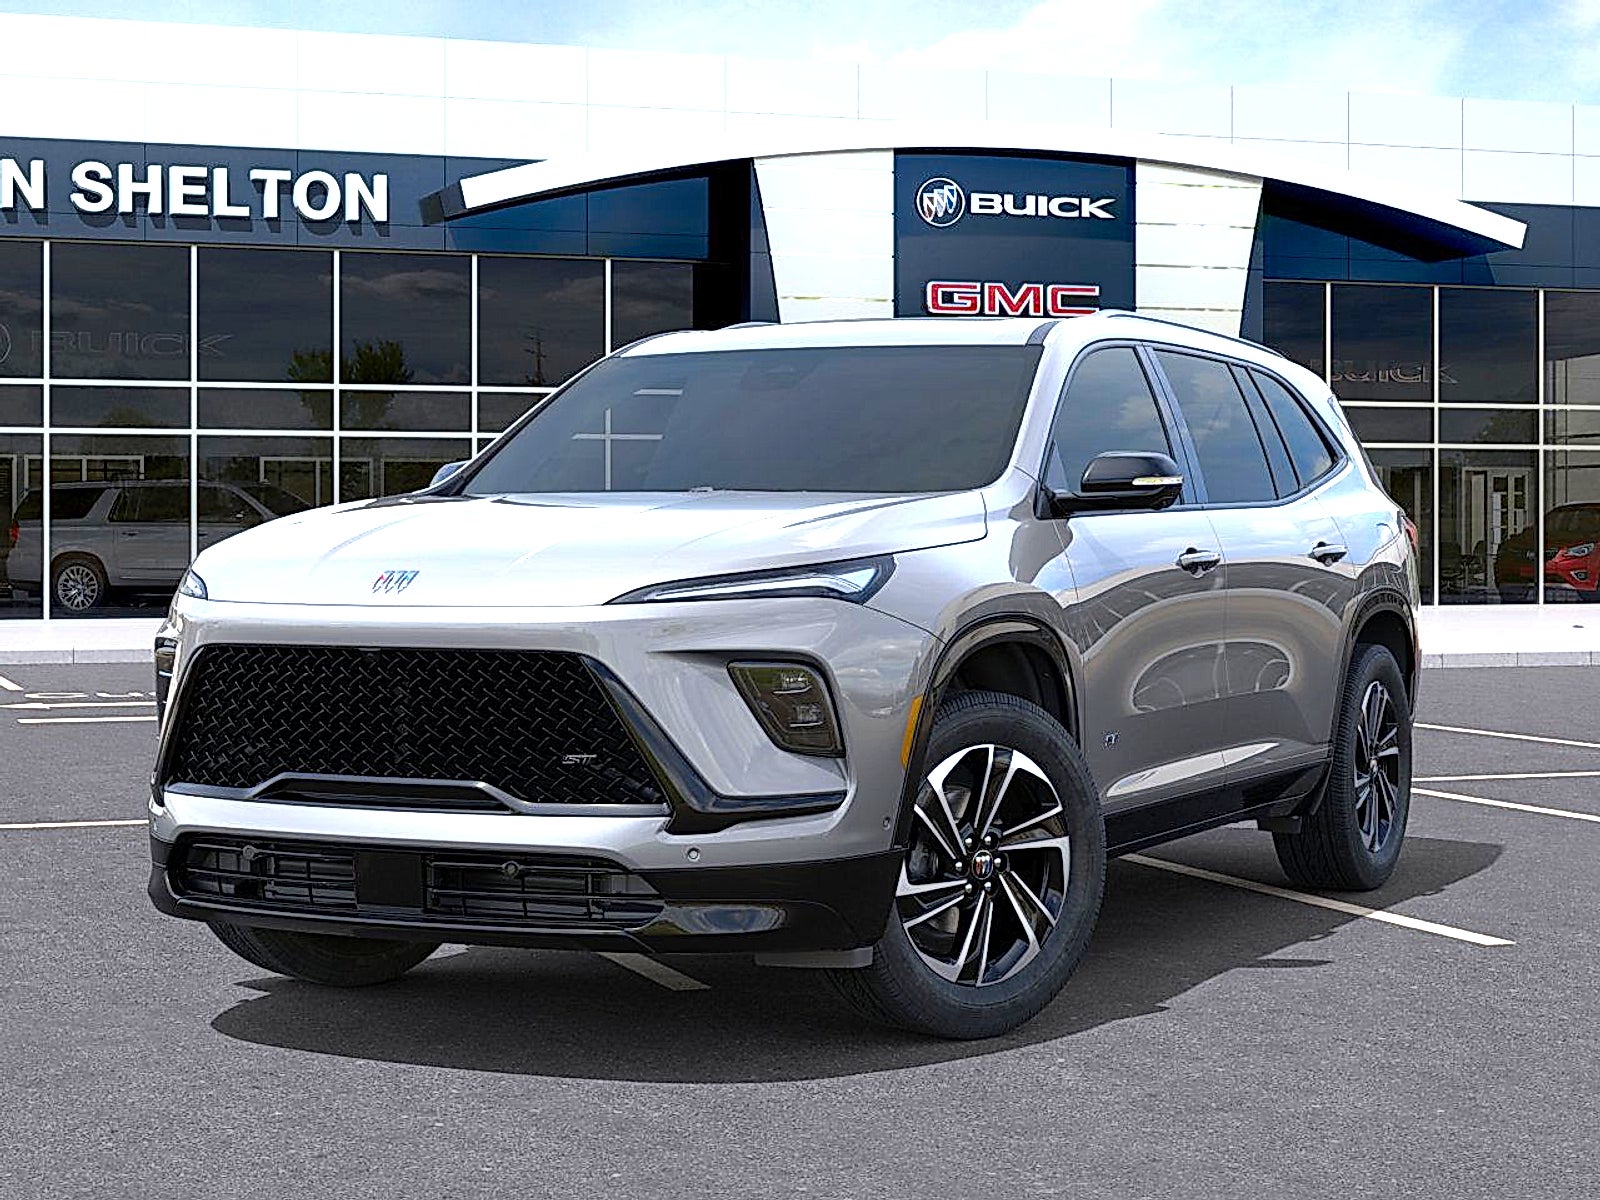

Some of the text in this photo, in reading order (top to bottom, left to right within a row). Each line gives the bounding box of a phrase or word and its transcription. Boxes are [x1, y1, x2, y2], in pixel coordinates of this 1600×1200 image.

[70, 160, 388, 222] SHELTON
[970, 192, 1116, 219] BUICK
[926, 281, 1100, 316] GMC
